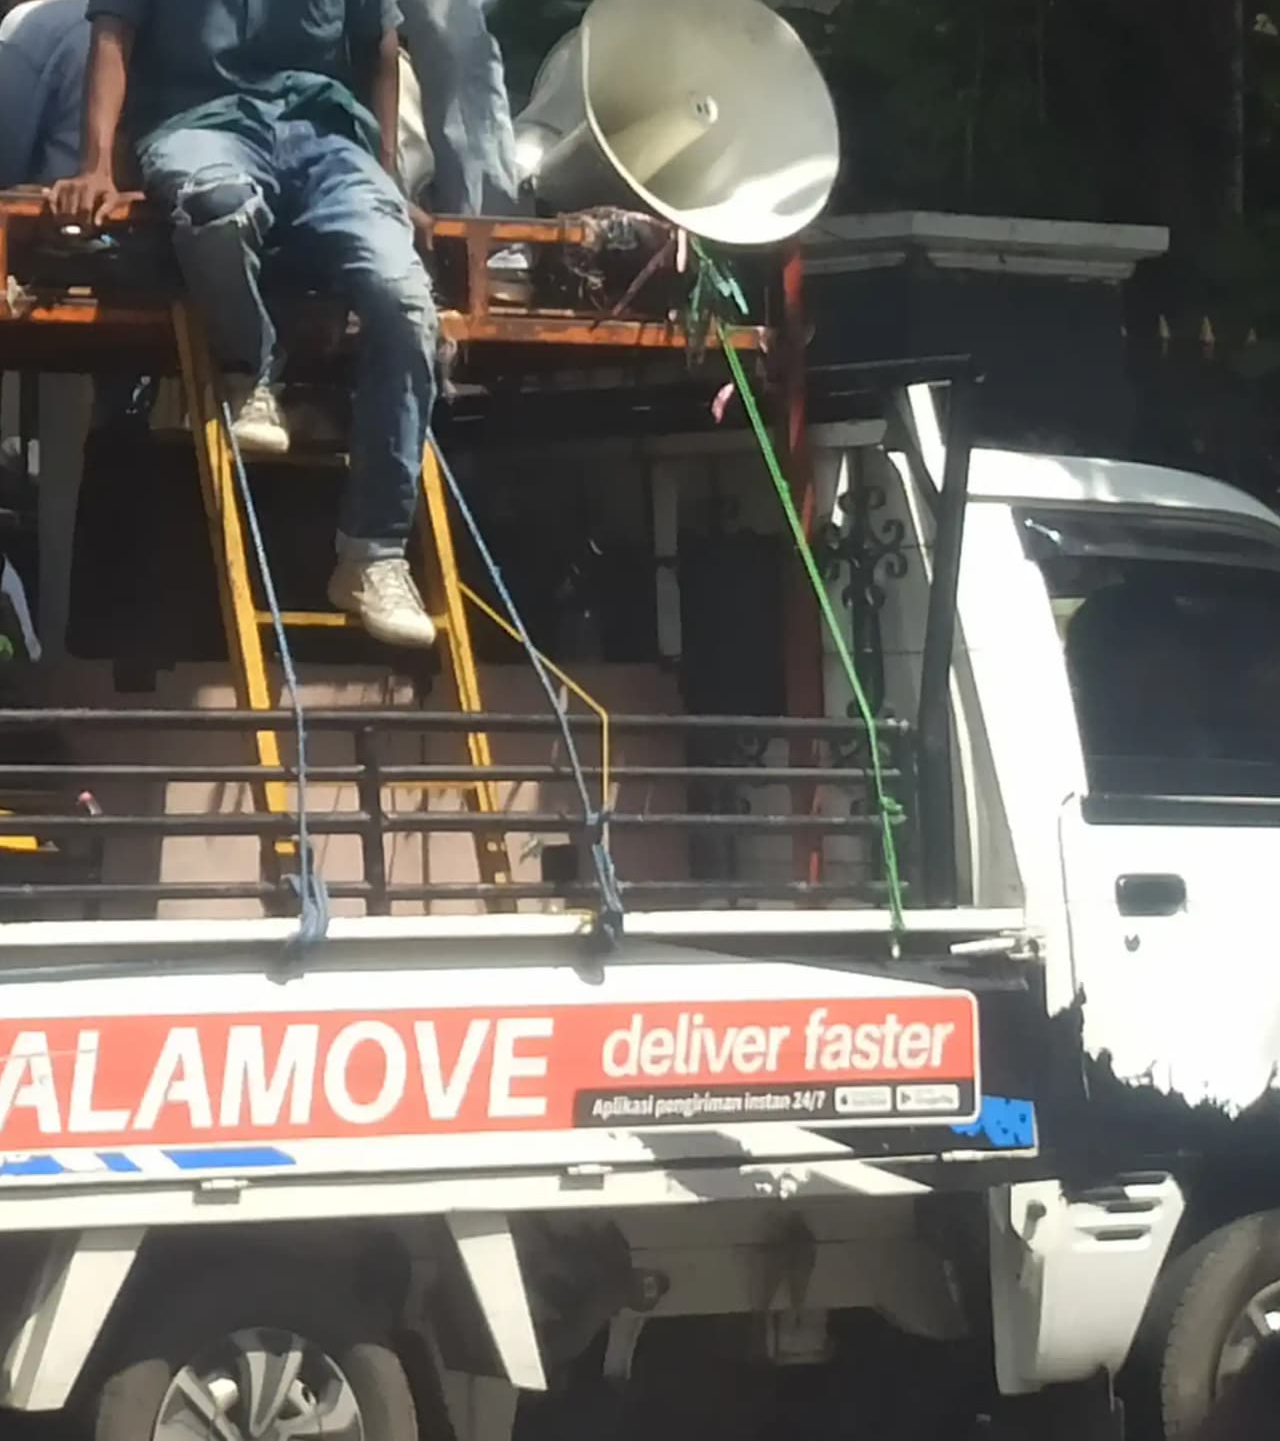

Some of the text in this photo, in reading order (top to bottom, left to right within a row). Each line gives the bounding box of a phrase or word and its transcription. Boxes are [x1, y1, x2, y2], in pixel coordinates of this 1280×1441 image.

[602, 1008, 955, 1078] deliver faster
[592, 1095, 654, 1120] Aplikasi
[655, 1091, 742, 1118] pengiriman
[744, 1092, 791, 1112] instan
[792, 1089, 827, 1112] 24/7
